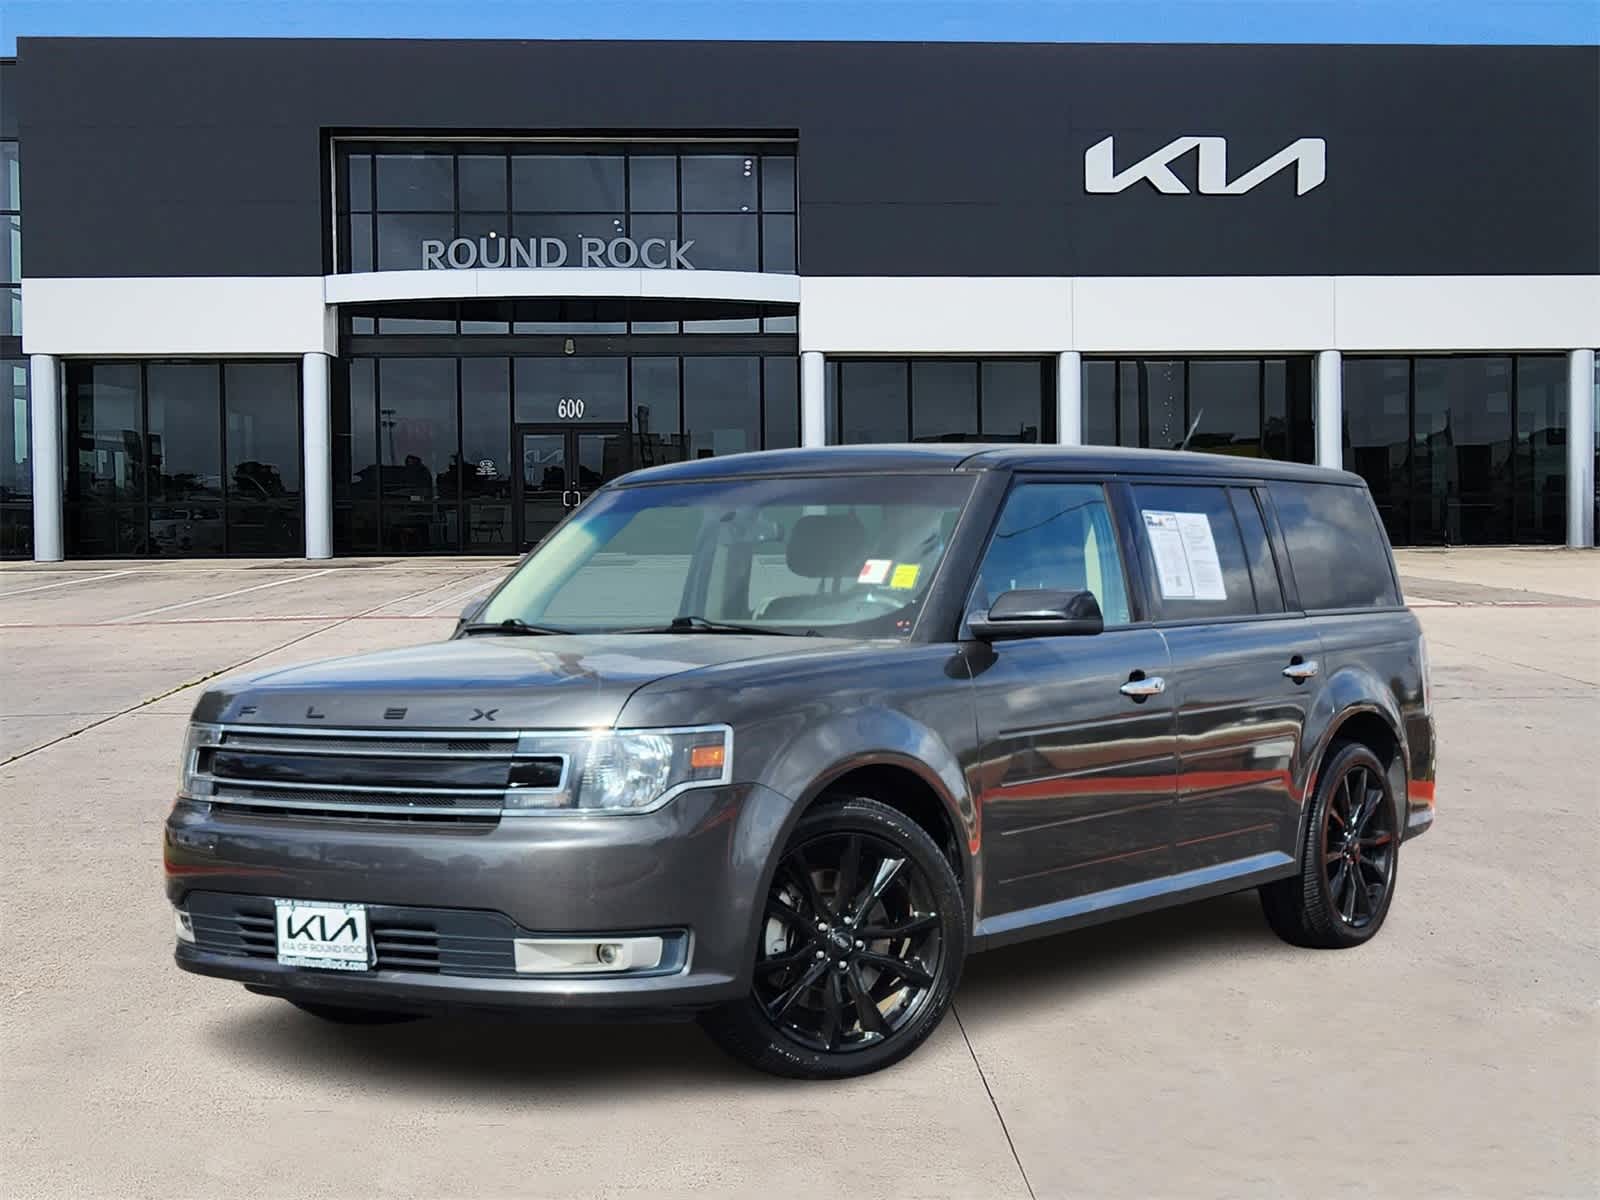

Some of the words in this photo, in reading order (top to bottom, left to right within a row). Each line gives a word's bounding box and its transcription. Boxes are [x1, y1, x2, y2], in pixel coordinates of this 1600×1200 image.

[1085, 136, 1326, 196] KIA
[421, 237, 568, 270] ROUND
[582, 237, 696, 270] ROCK
[558, 399, 584, 418] 600
[238, 705, 499, 721] FLEX
[287, 914, 358, 942] KIA
[310, 944, 341, 953] ROUND
